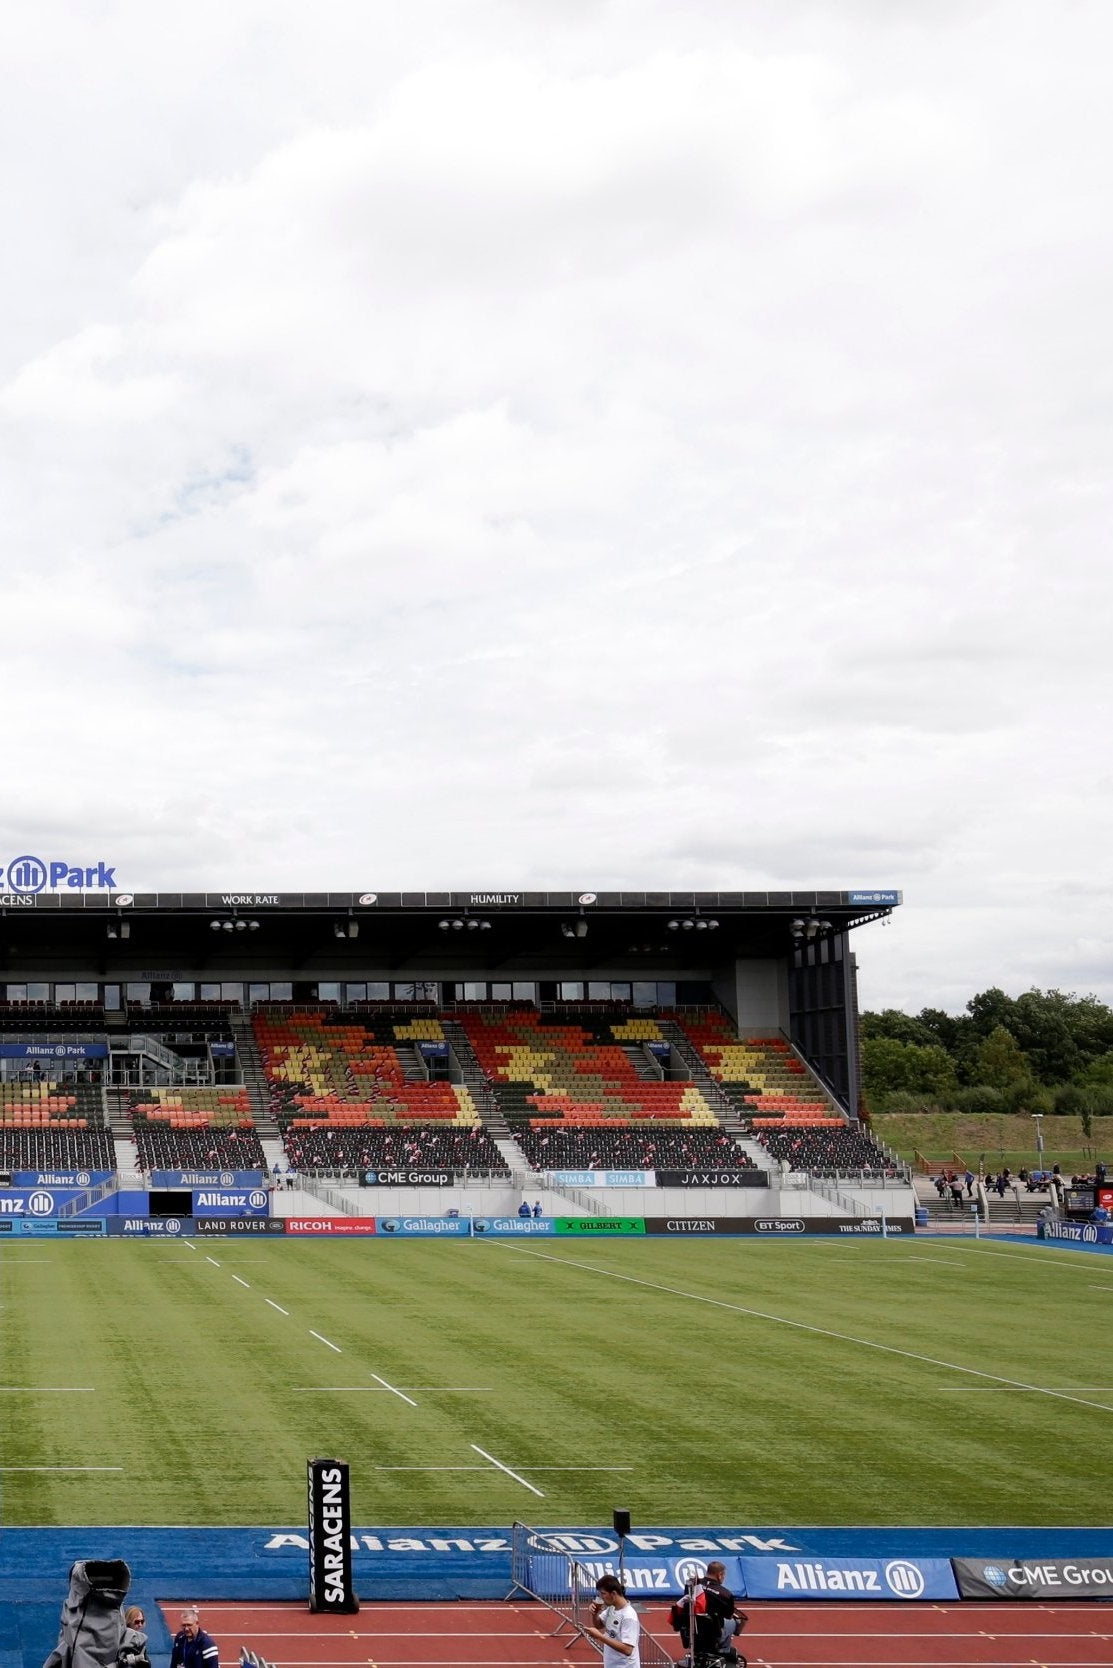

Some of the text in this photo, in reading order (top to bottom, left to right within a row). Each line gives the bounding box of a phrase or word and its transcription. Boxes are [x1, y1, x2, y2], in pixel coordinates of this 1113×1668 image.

[50, 862, 117, 888] Park
[221, 895, 279, 905] WORK RATE
[470, 894, 519, 904] HUMILITY
[26, 1046, 86, 1055] Allianz Park
[37, 1174, 75, 1185] Allianz
[180, 1174, 218, 1185] Allianz
[378, 1172, 448, 1185] CME Group
[559, 1174, 592, 1184] SIMBA
[609, 1174, 642, 1184] SIMBA
[681, 1174, 740, 1184] JAXJOX
[197, 1193, 246, 1206] Allianz
[124, 1220, 164, 1231] Allianz
[198, 1221, 226, 1230] LAND
[231, 1221, 266, 1230] ROVER
[289, 1221, 332, 1231] RICOH
[403, 1219, 461, 1232] Gallagher
[493, 1219, 550, 1232] Gallagher
[579, 1221, 622, 1230] GILBERT
[666, 1220, 716, 1231] CITIZEN
[759, 1221, 800, 1231] BT Sport
[1045, 1222, 1082, 1241] Allianz
[321, 1468, 345, 1604] SARACENS
[629, 1534, 802, 1551] Park
[777, 1563, 882, 1591] Allianz
[1007, 1566, 1062, 1586] CME
